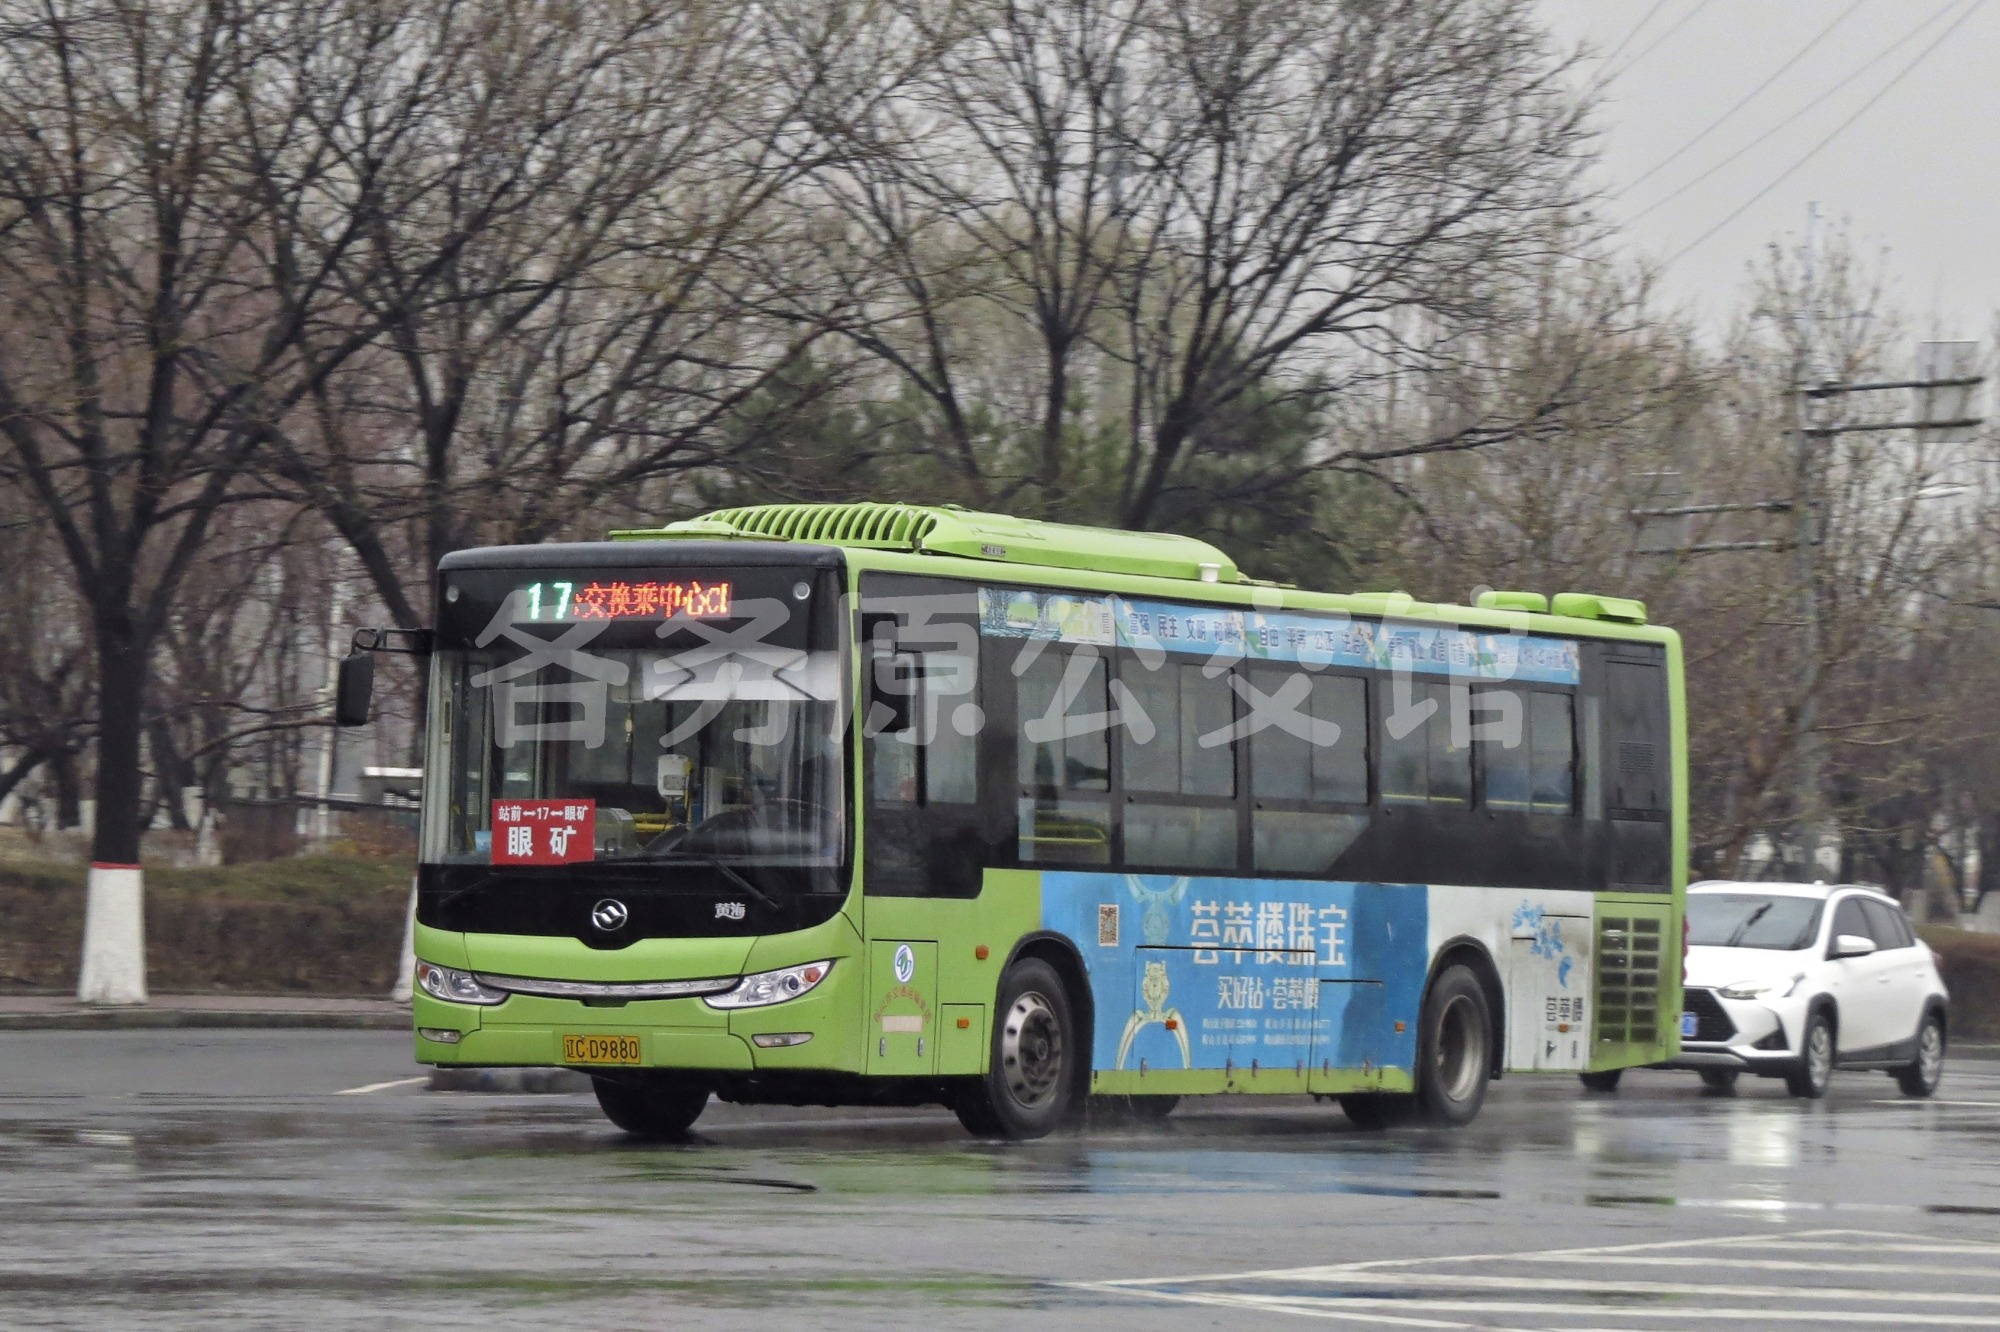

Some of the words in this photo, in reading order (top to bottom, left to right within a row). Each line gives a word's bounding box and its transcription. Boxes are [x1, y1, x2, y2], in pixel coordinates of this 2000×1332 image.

[528, 582, 573, 620] 17
[1158, 614, 1179, 638] 民主
[498, 805, 522, 822] 站前
[537, 807, 550, 820] 17
[564, 805, 589, 821] 眼矿
[508, 825, 577, 857] 眼矿
[715, 902, 746, 920] 黄海
[1191, 900, 1348, 966] 荟萃楼珠宝
